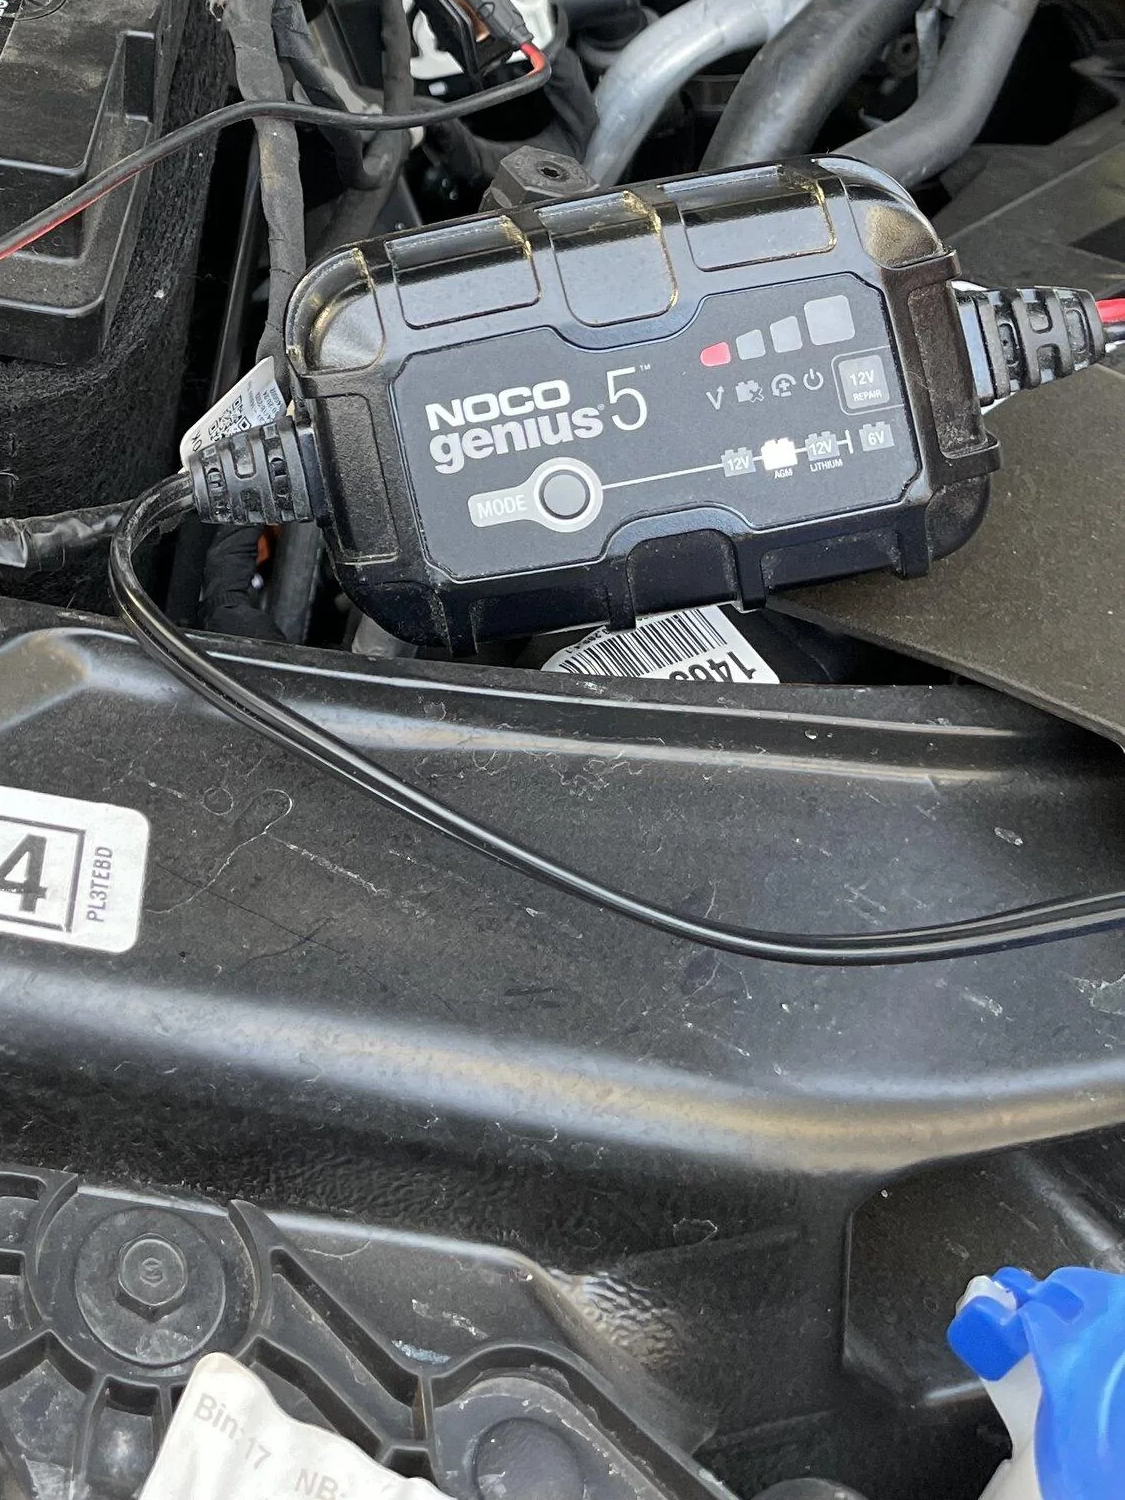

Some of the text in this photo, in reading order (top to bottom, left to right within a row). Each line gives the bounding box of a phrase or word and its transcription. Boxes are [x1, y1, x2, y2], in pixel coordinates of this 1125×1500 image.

[850, 370, 875, 385] 12V
[425, 380, 570, 430] NOCO
[852, 389, 882, 401] REPAIR
[728, 431, 885, 471] 12V 12V 6V
[774, 459, 843, 478] AGM LITHIUM
[477, 495, 528, 519] MODE
[86, 846, 113, 922] PL3TEBD
[245, 1438, 272, 1470] 17
